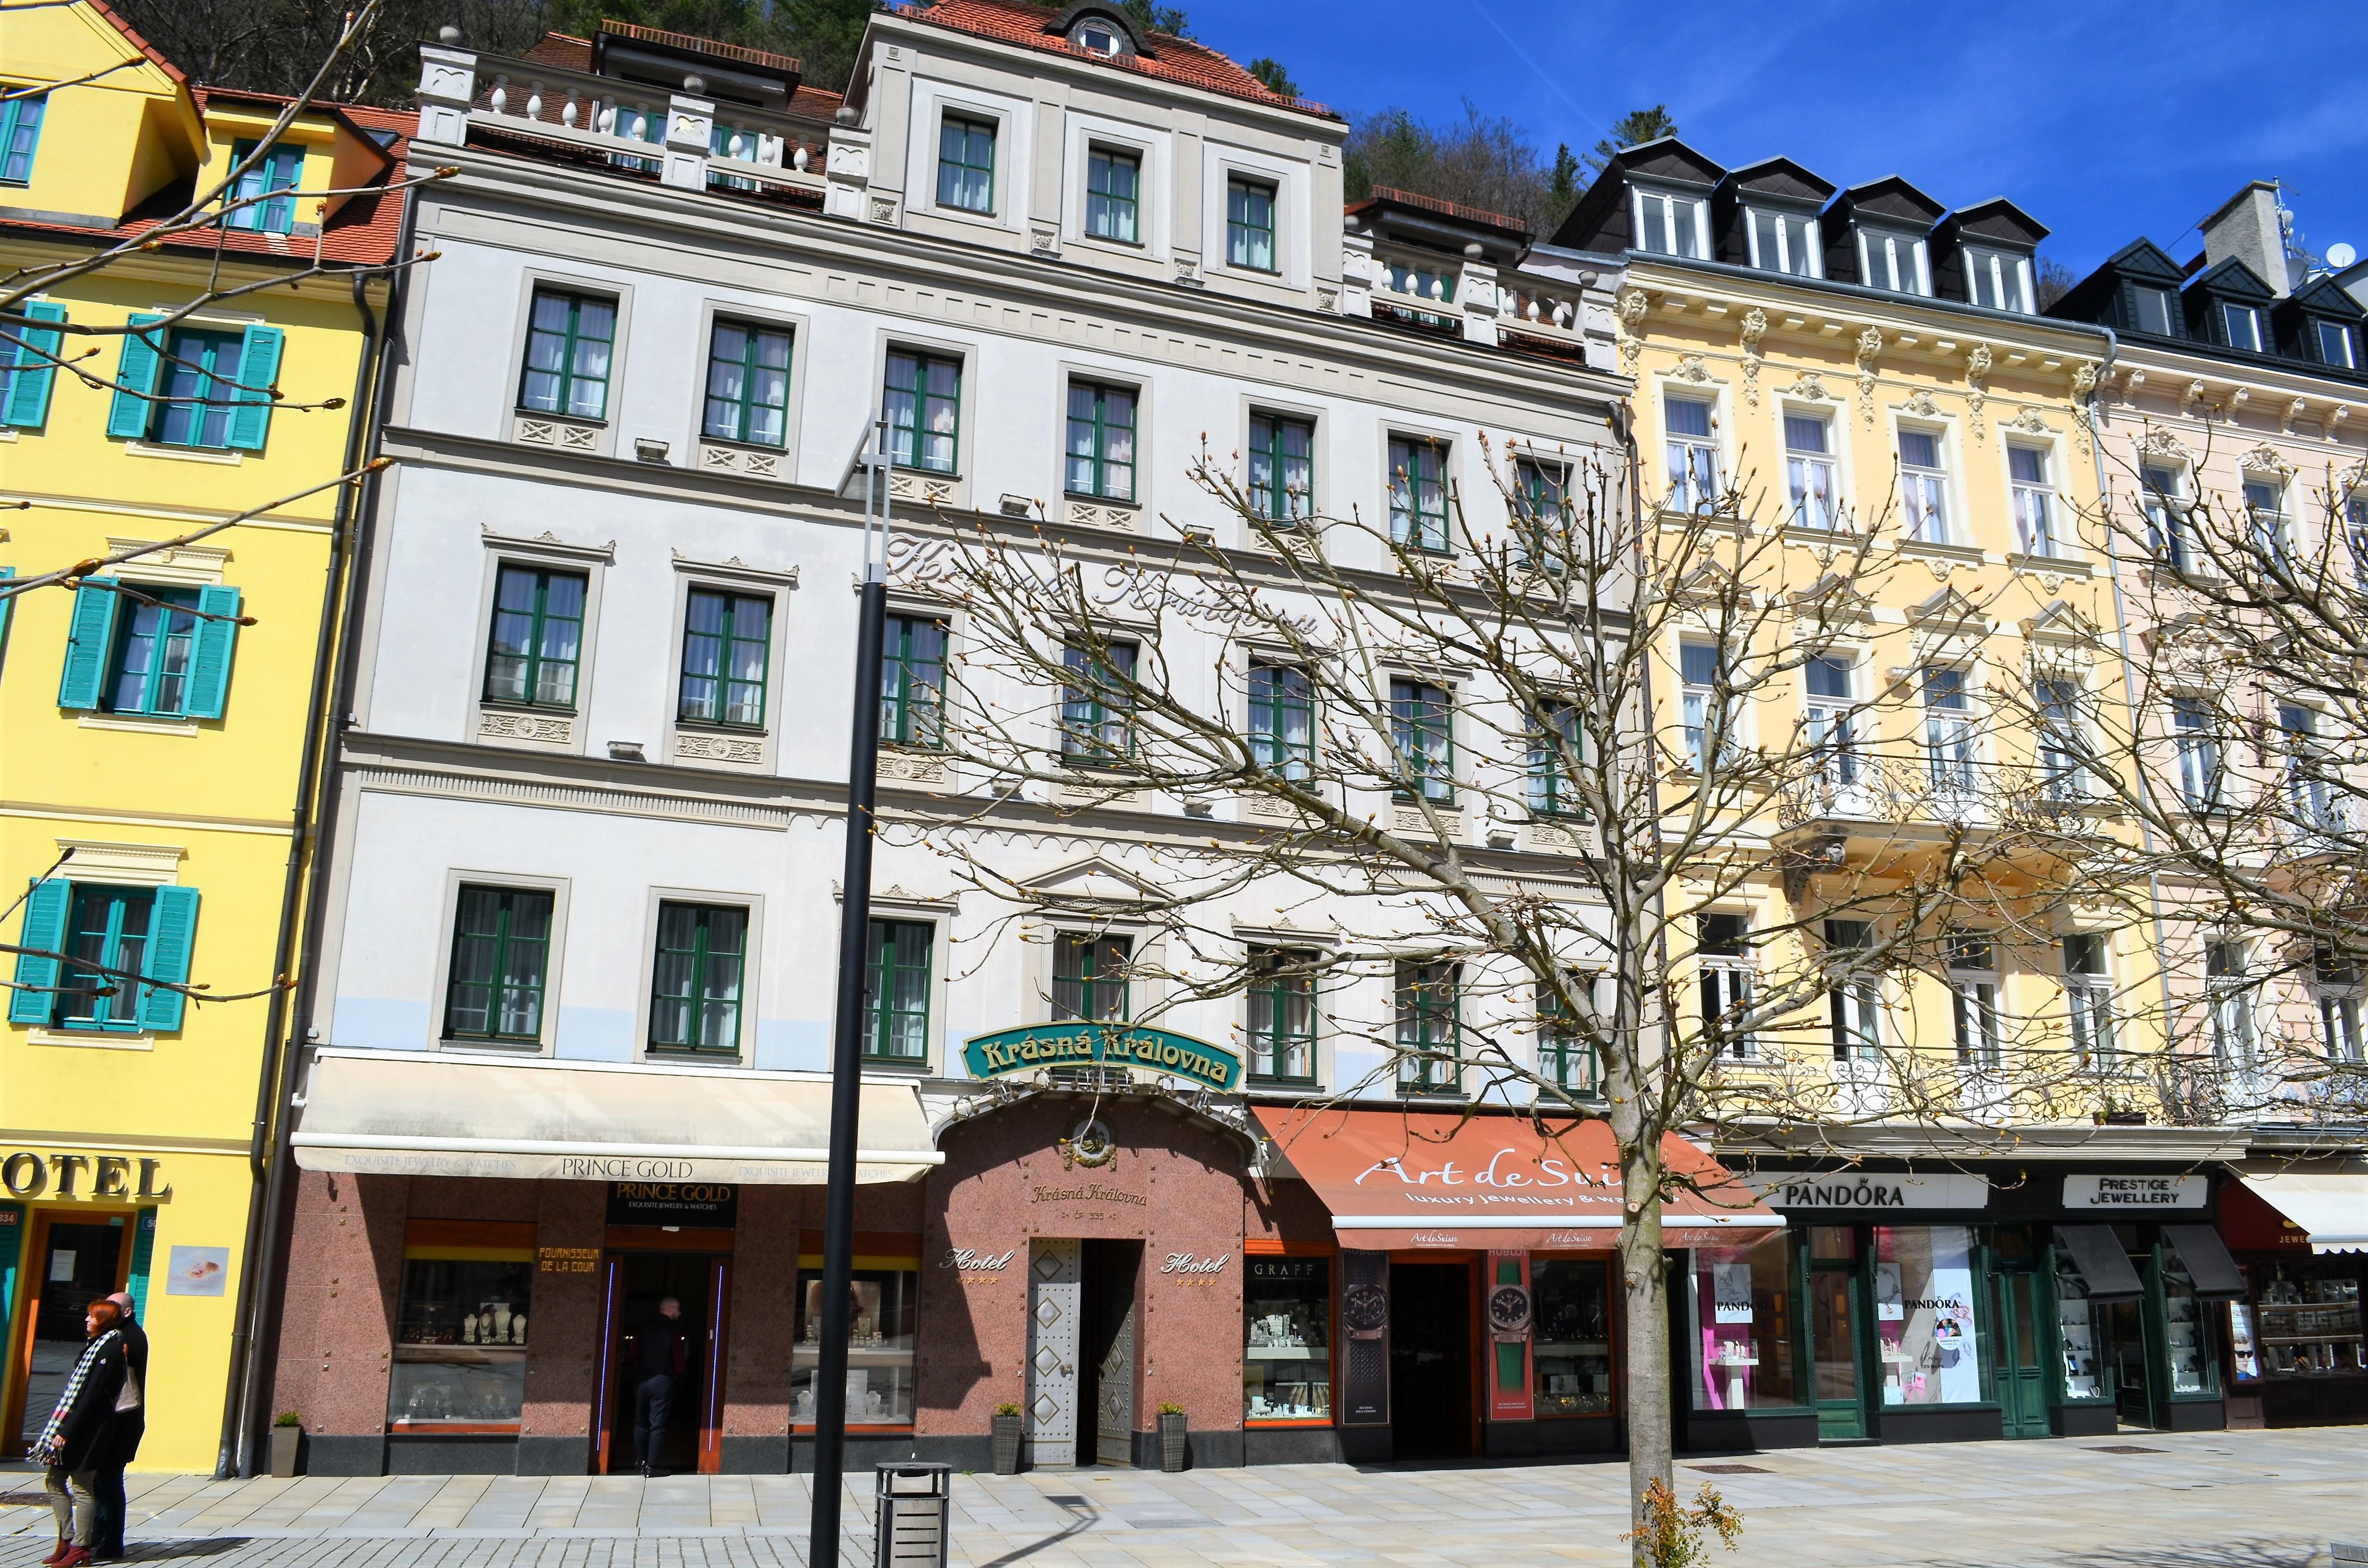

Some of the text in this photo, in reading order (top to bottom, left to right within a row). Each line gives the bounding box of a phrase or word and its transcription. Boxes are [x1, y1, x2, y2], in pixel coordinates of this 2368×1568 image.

[981, 1030, 1229, 1083] Krásná Královna
[345, 1154, 516, 1170] EXQUISITE JEWELRY & WATCHES
[562, 1158, 693, 1178] PRINCE GOLD
[1355, 1148, 1623, 1188] Art de Sui
[0, 1152, 170, 1195] OTEL
[739, 1166, 894, 1178] EXQUISITE JEWELR ATCHES
[617, 1182, 730, 1201] PRINCE GOLD
[2099, 1178, 2169, 1191] PRESTIGE
[1031, 1185, 1083, 1203] Krásná
[1406, 1192, 1474, 1205] luxury
[1480, 1193, 1574, 1206] jewellery
[1579, 1195, 1595, 1203] &
[1786, 1184, 1904, 1206] PANDORA
[2090, 1191, 2179, 1204] JEWELLERY
[1411, 1233, 1426, 1242] Art
[1436, 1233, 1458, 1242] Suisse
[1546, 1233, 1562, 1243] Art
[539, 1248, 599, 1259] FOURNISSEUR
[939, 1248, 1014, 1271] Hotel
[542, 1261, 595, 1272] DE LA COUR
[1160, 1252, 1231, 1274] Hotel
[1255, 1264, 1313, 1275] GRAFF
[1717, 1301, 1776, 1311] PANDORA
[1905, 1298, 1960, 1309] PANDORA
